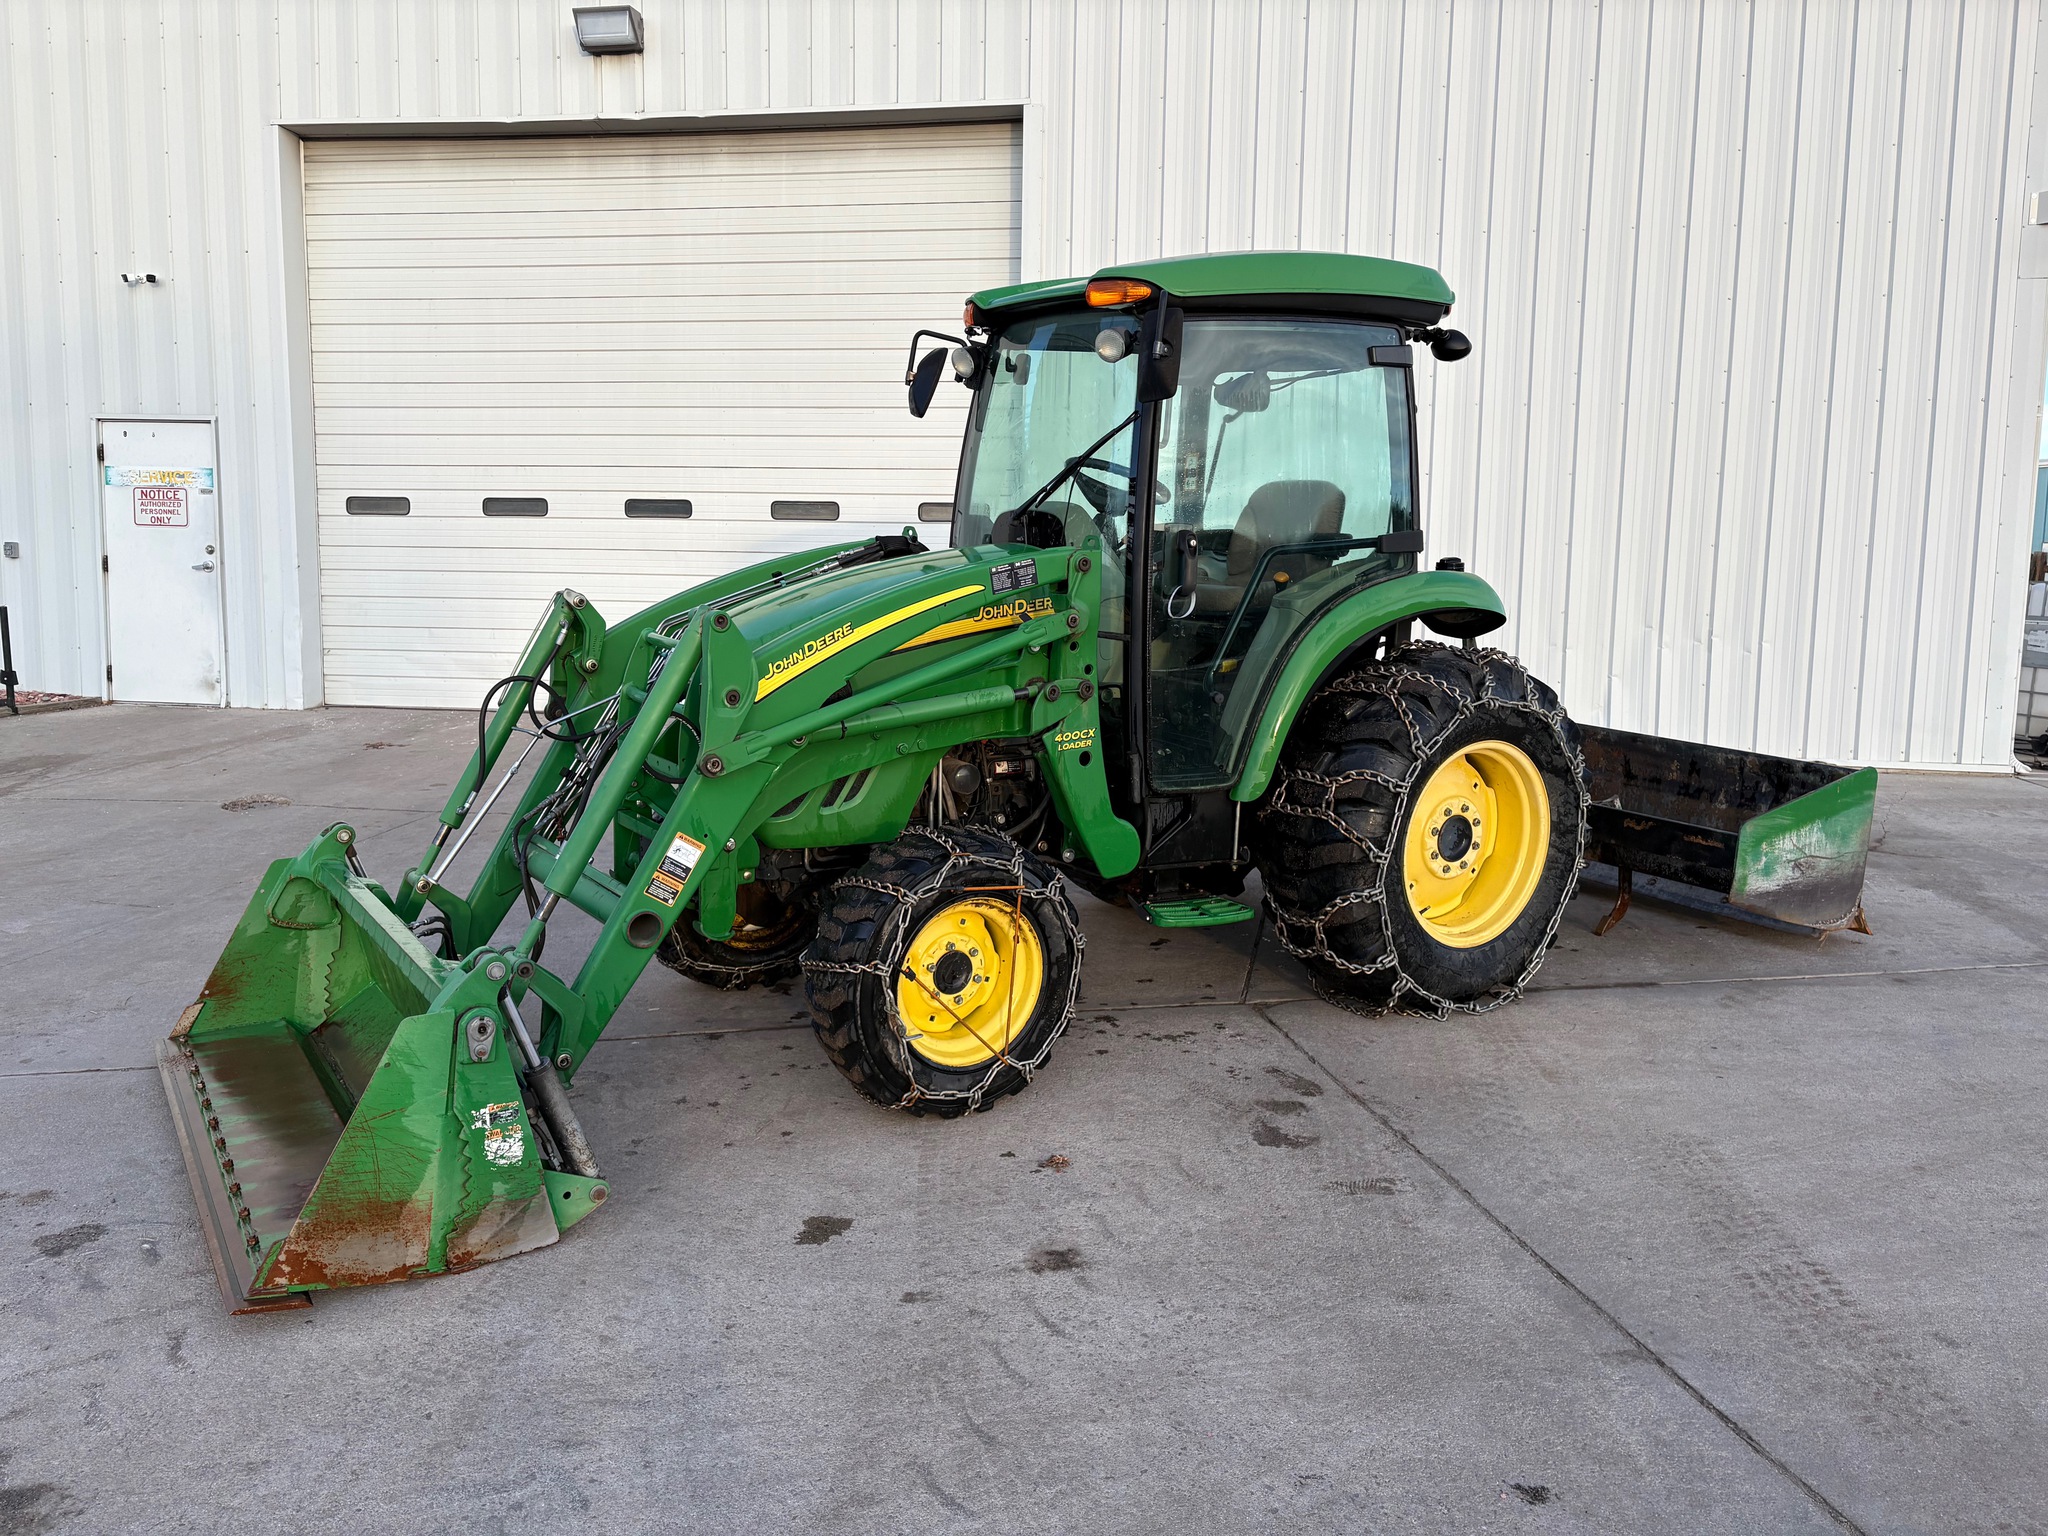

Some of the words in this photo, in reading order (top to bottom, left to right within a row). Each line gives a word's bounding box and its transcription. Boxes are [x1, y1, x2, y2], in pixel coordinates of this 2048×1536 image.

[140, 489, 180, 500] NOTICE
[140, 508, 181, 516] PERSONNEL
[150, 516, 172, 524] ONLY
[973, 604, 1013, 621] JOHN
[1014, 597, 1054, 614] DEER
[764, 648, 804, 680] JOHN
[803, 621, 853, 658] DEERE
[1054, 727, 1096, 742] 400CX
[1057, 739, 1092, 751] LOADER
[683, 836, 702, 849] WARNING
[661, 877, 680, 889] WARNING
